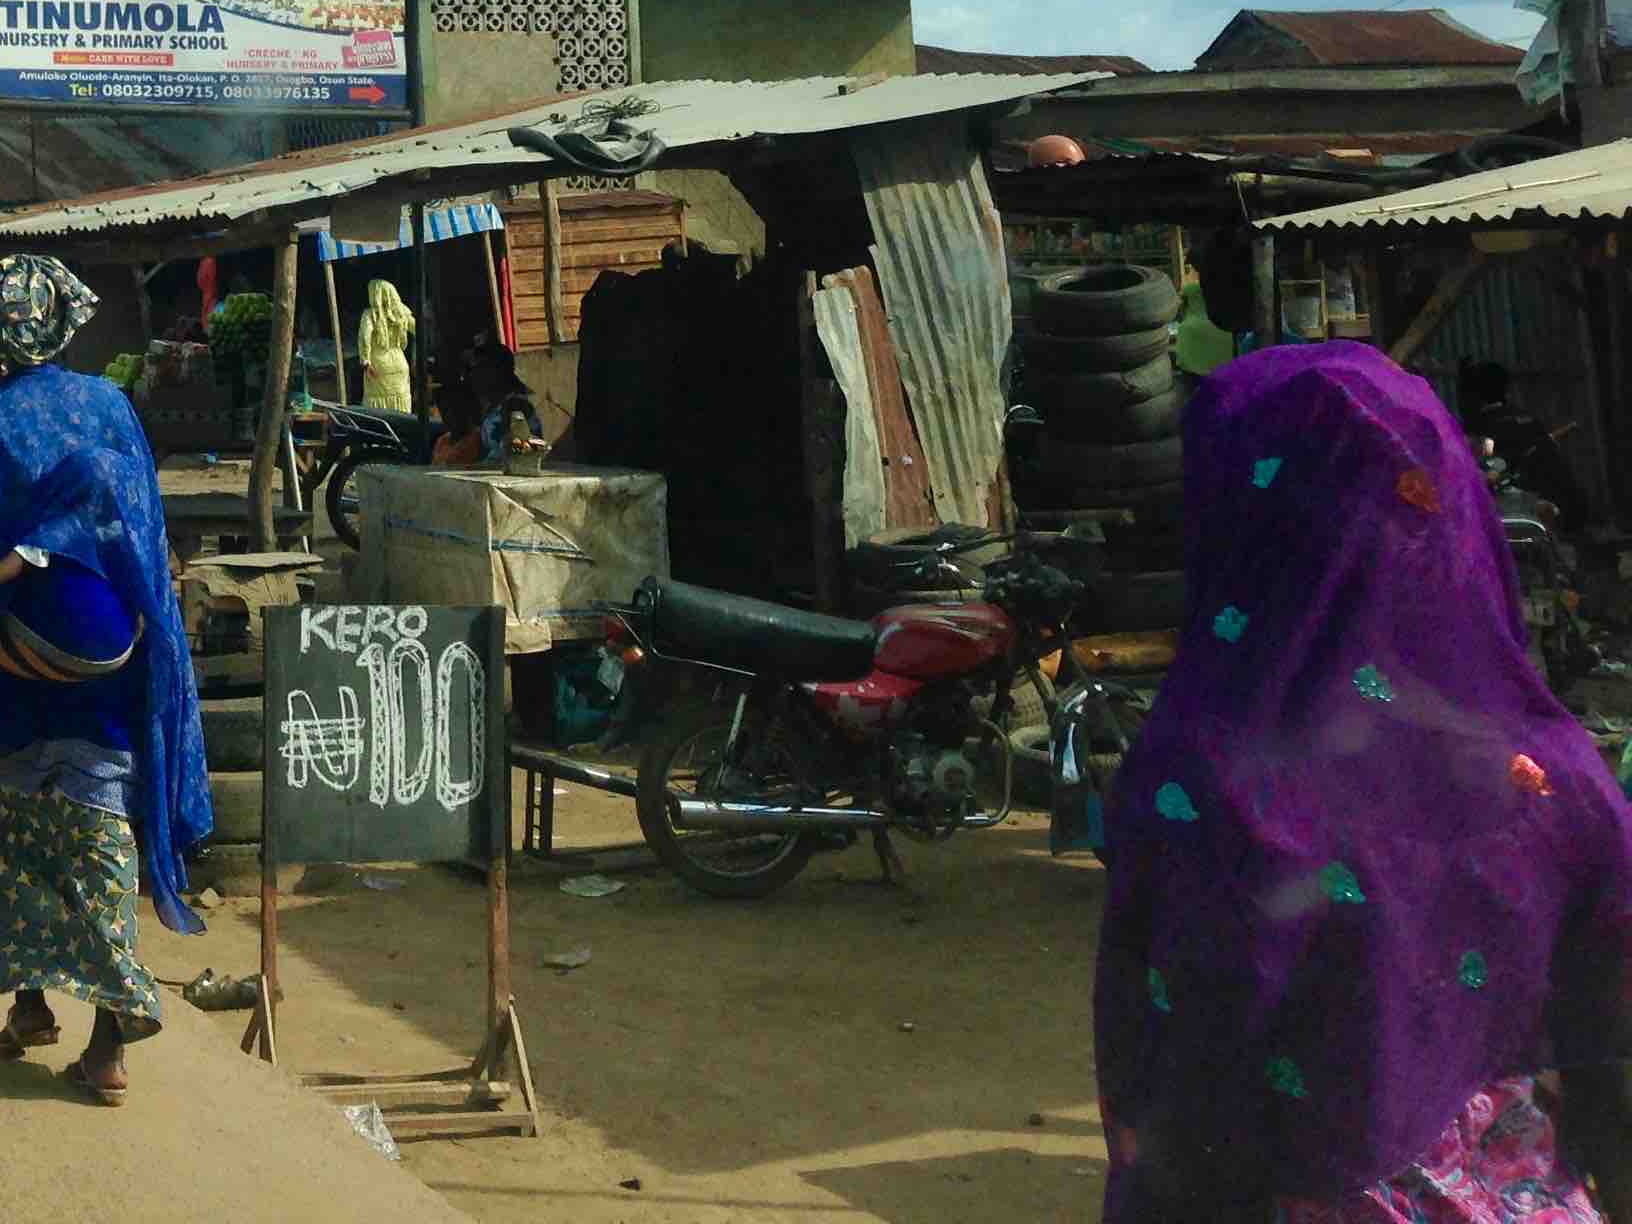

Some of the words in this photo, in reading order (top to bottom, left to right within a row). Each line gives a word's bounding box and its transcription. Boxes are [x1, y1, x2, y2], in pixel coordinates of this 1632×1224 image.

[0, 0, 225, 33] TINUMOLA
[74, 33, 87, 48] &
[92, 34, 164, 49] PRIMARY
[169, 34, 229, 51] SCHOOL
[115, 55, 141, 65] WITH
[142, 55, 168, 65] LOVE
[319, 75, 346, 85] Osun
[69, 82, 97, 97] Tel:
[101, 84, 219, 100] 08032309715,
[300, 605, 429, 654] KERO
